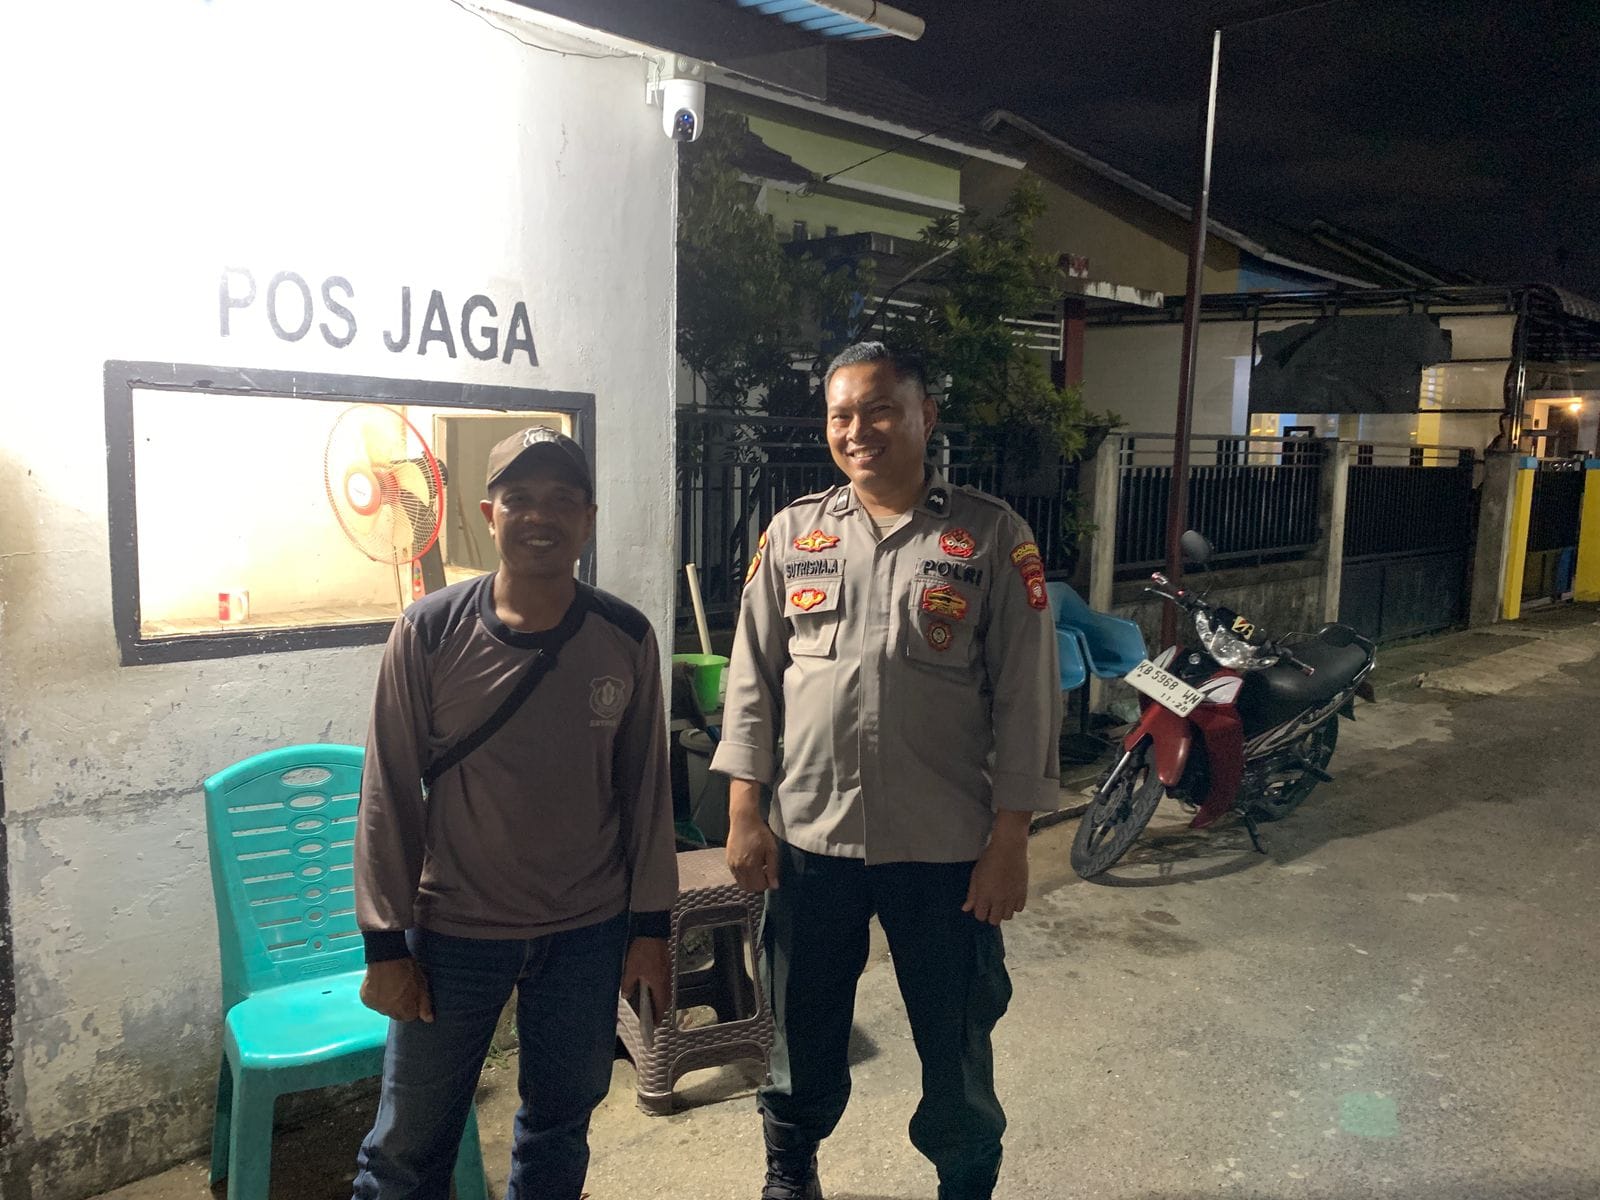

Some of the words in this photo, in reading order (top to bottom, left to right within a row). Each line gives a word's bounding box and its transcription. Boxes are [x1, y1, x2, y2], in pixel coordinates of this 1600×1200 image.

[219, 266, 357, 349] POS
[383, 286, 539, 367] JAGA
[923, 560, 983, 587] POLRI
[1137, 663, 1152, 676] KB
[1152, 671, 1179, 690] 5968
